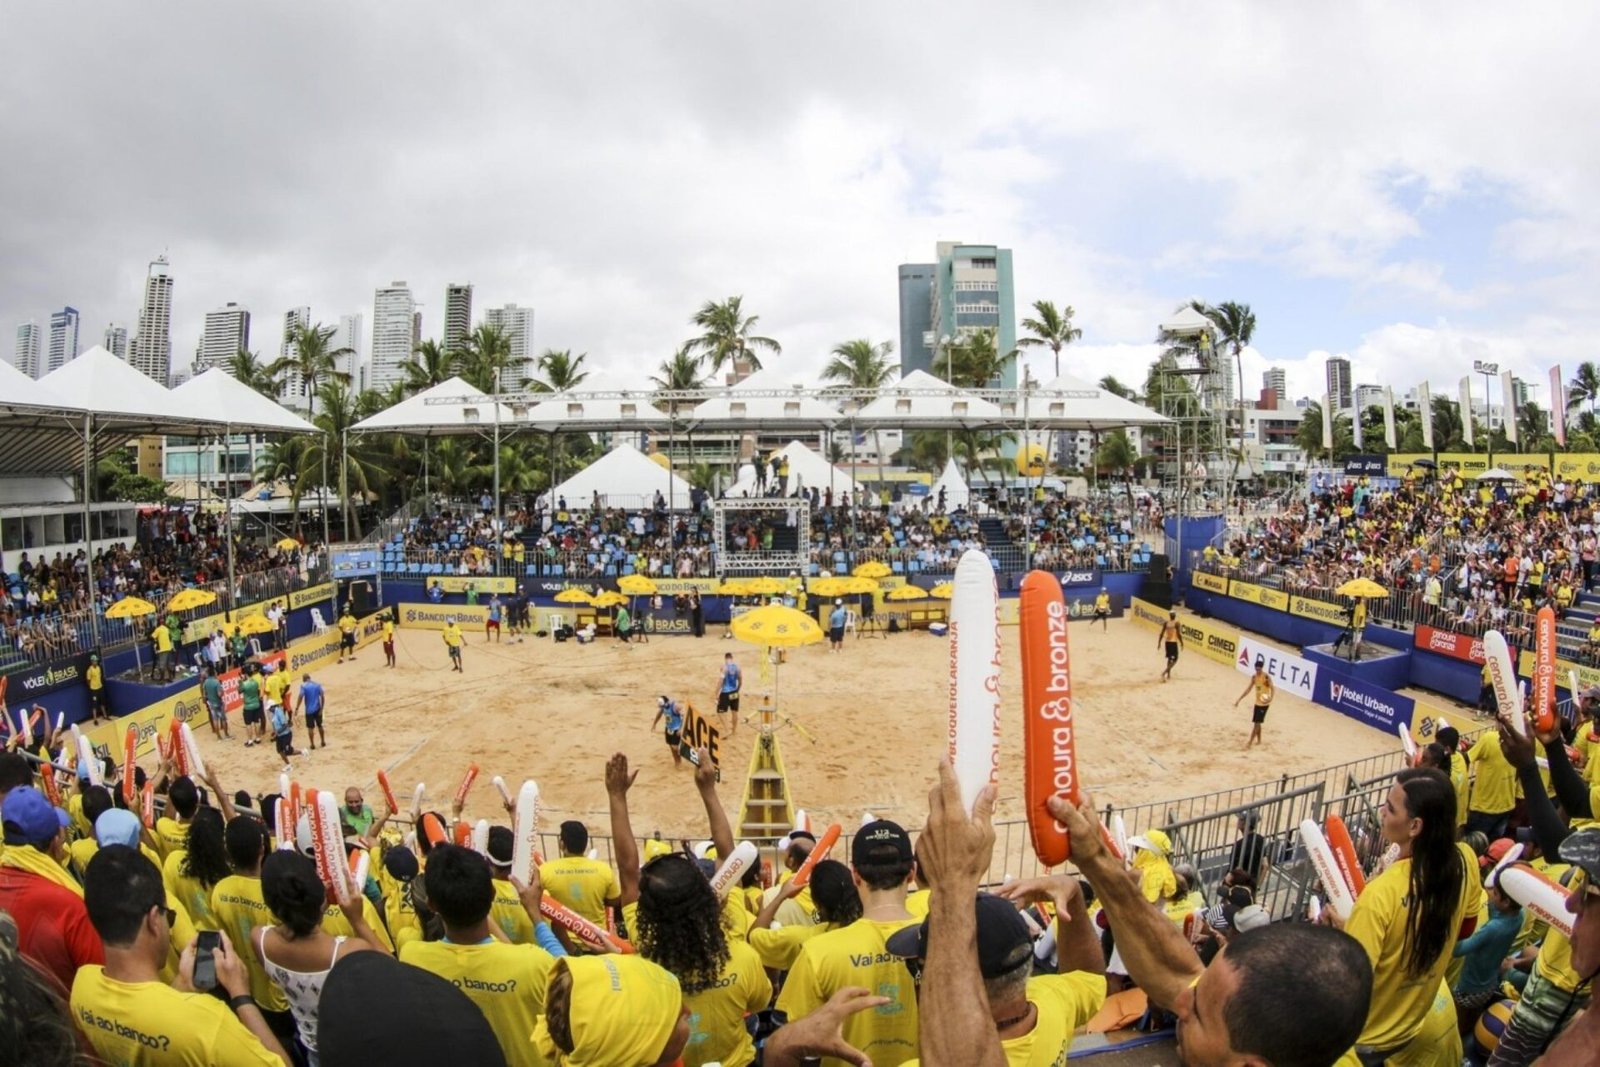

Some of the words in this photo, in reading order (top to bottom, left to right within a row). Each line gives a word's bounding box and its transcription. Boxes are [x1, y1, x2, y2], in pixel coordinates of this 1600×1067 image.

[1071, 572, 1093, 581] asics
[418, 611, 443, 622] BANCO
[457, 612, 484, 623] BRASIL
[656, 618, 691, 630] BRASIL
[1181, 624, 1204, 641] CIMED
[1208, 634, 1236, 653] CIMED
[1539, 619, 1549, 666] cenoura
[1046, 600, 1069, 693] bronze
[23, 675, 46, 690] VÔLEI
[54, 665, 79, 684] BRASIL
[1256, 652, 1311, 690] DELTA
[1488, 656, 1508, 701] cenoura
[1040, 696, 1073, 722] &
[1343, 687, 1364, 705] Hotel
[1364, 695, 1395, 717] Urbano
[682, 703, 719, 766] ACE
[714, 857, 744, 891] cenoura
[229, 896, 240, 904] ao
[240, 896, 268, 912] banco?
[850, 953, 873, 968] Vai
[463, 977, 517, 993] banco?
[78, 1004, 96, 1026] Vai
[96, 1015, 114, 1032] ao
[114, 1018, 170, 1053] banco?
